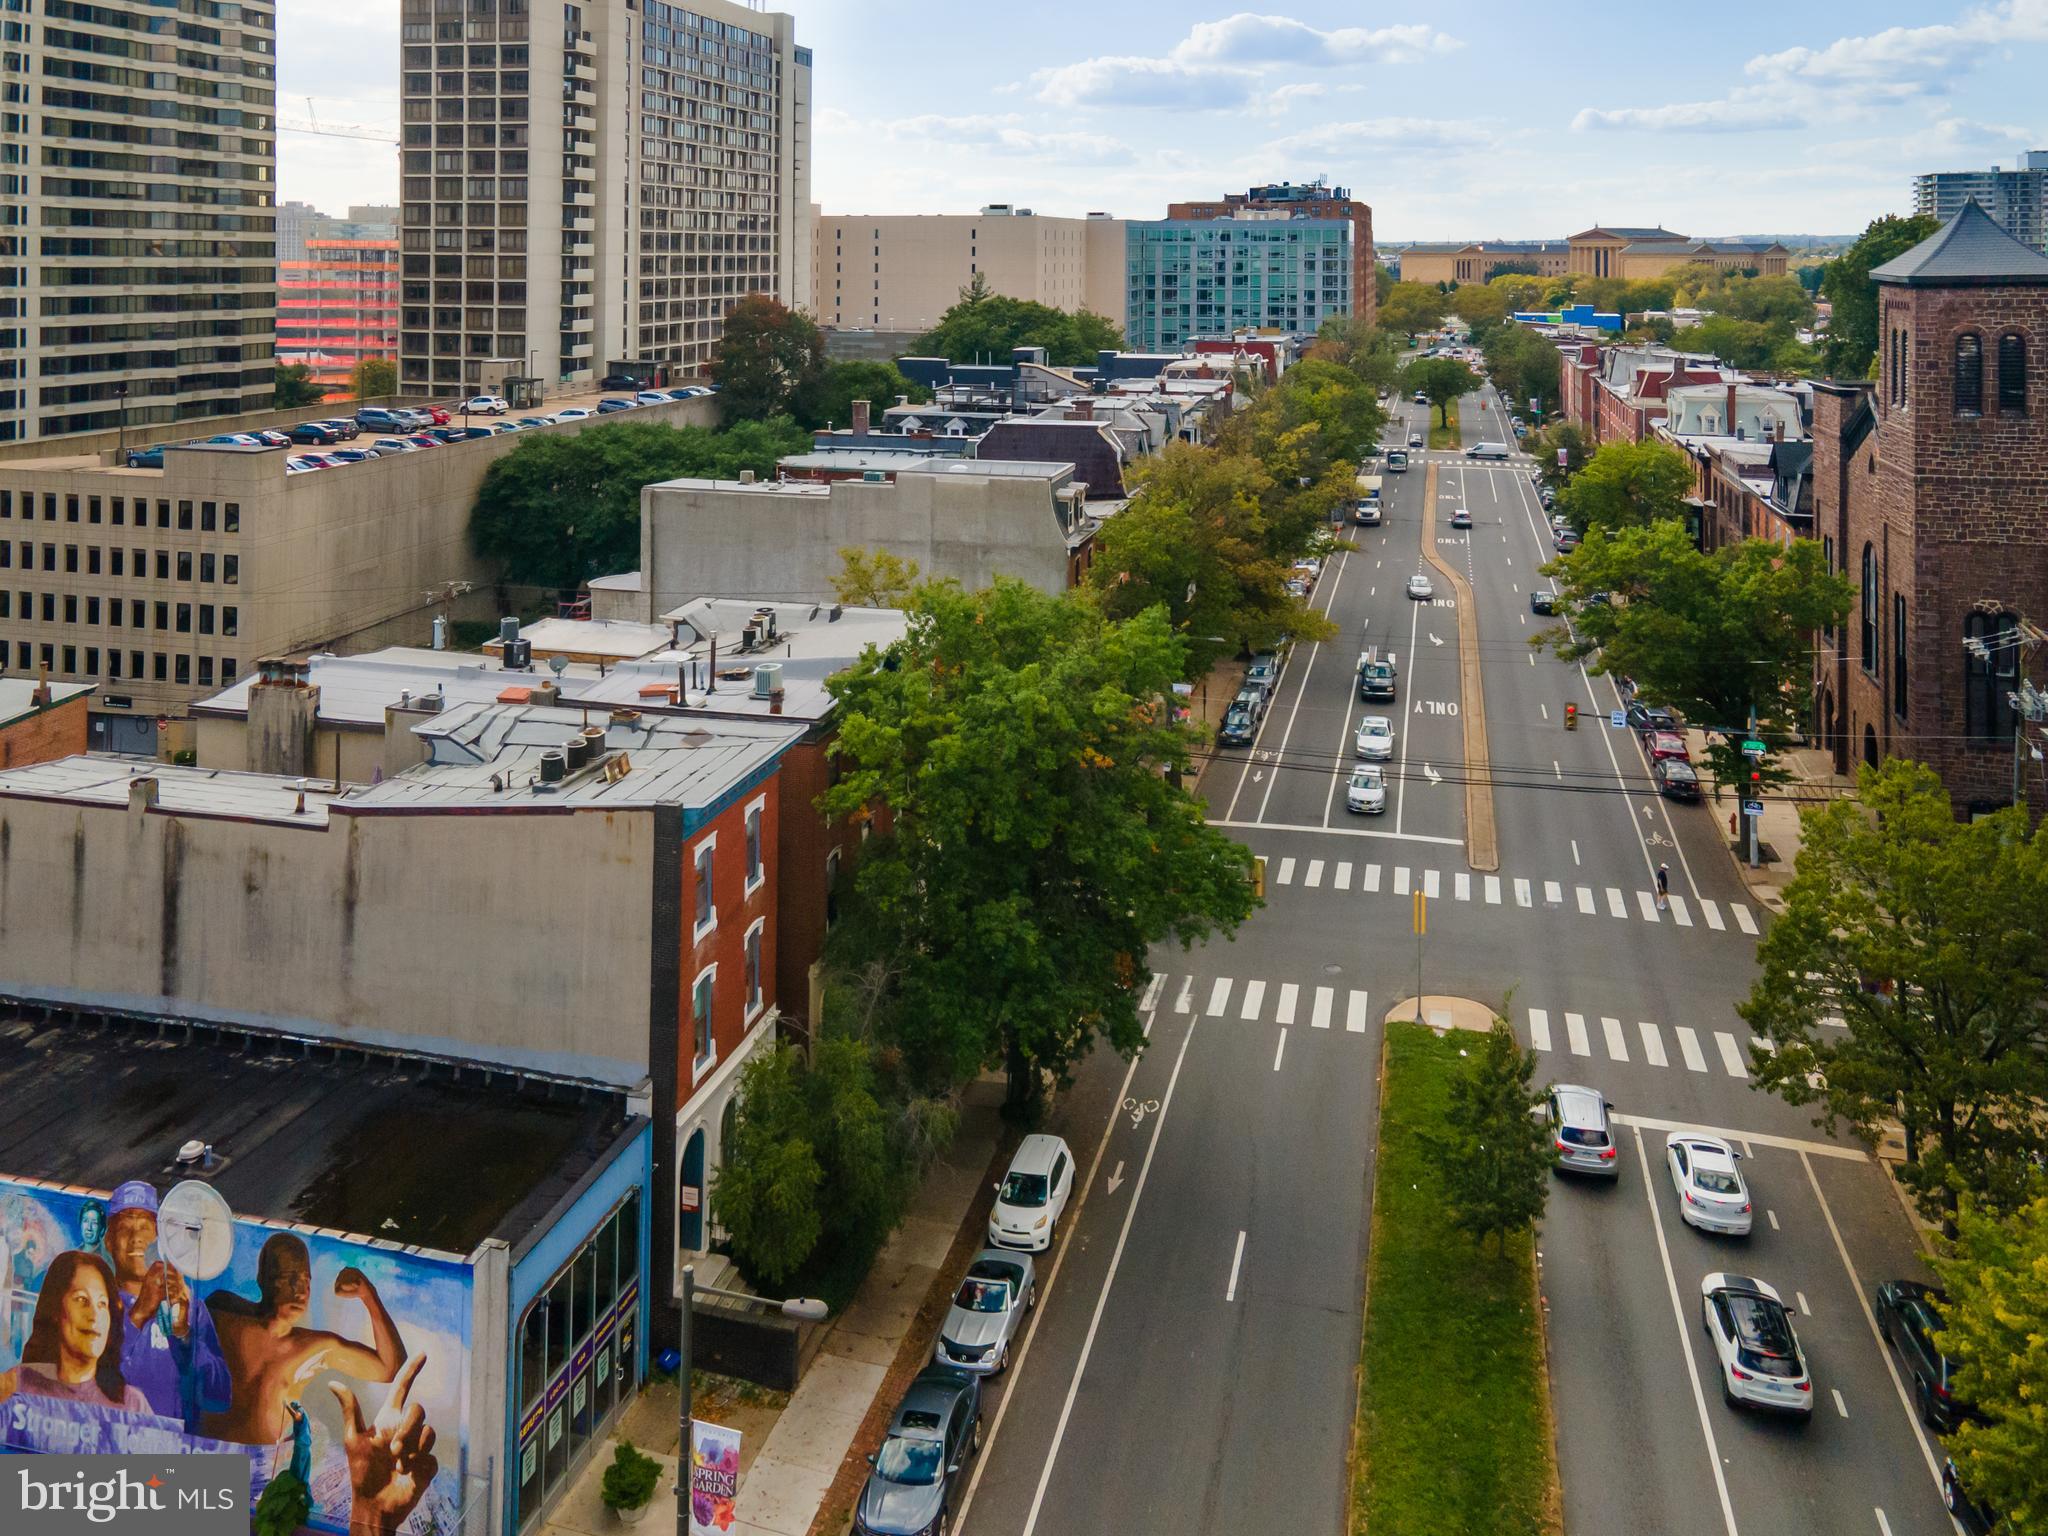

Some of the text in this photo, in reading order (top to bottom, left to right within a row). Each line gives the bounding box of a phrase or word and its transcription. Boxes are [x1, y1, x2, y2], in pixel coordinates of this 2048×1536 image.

[1414, 700, 1458, 716] ONLY
[694, 1466, 734, 1486] SPRING
[693, 1478, 733, 1496] GARDEN
